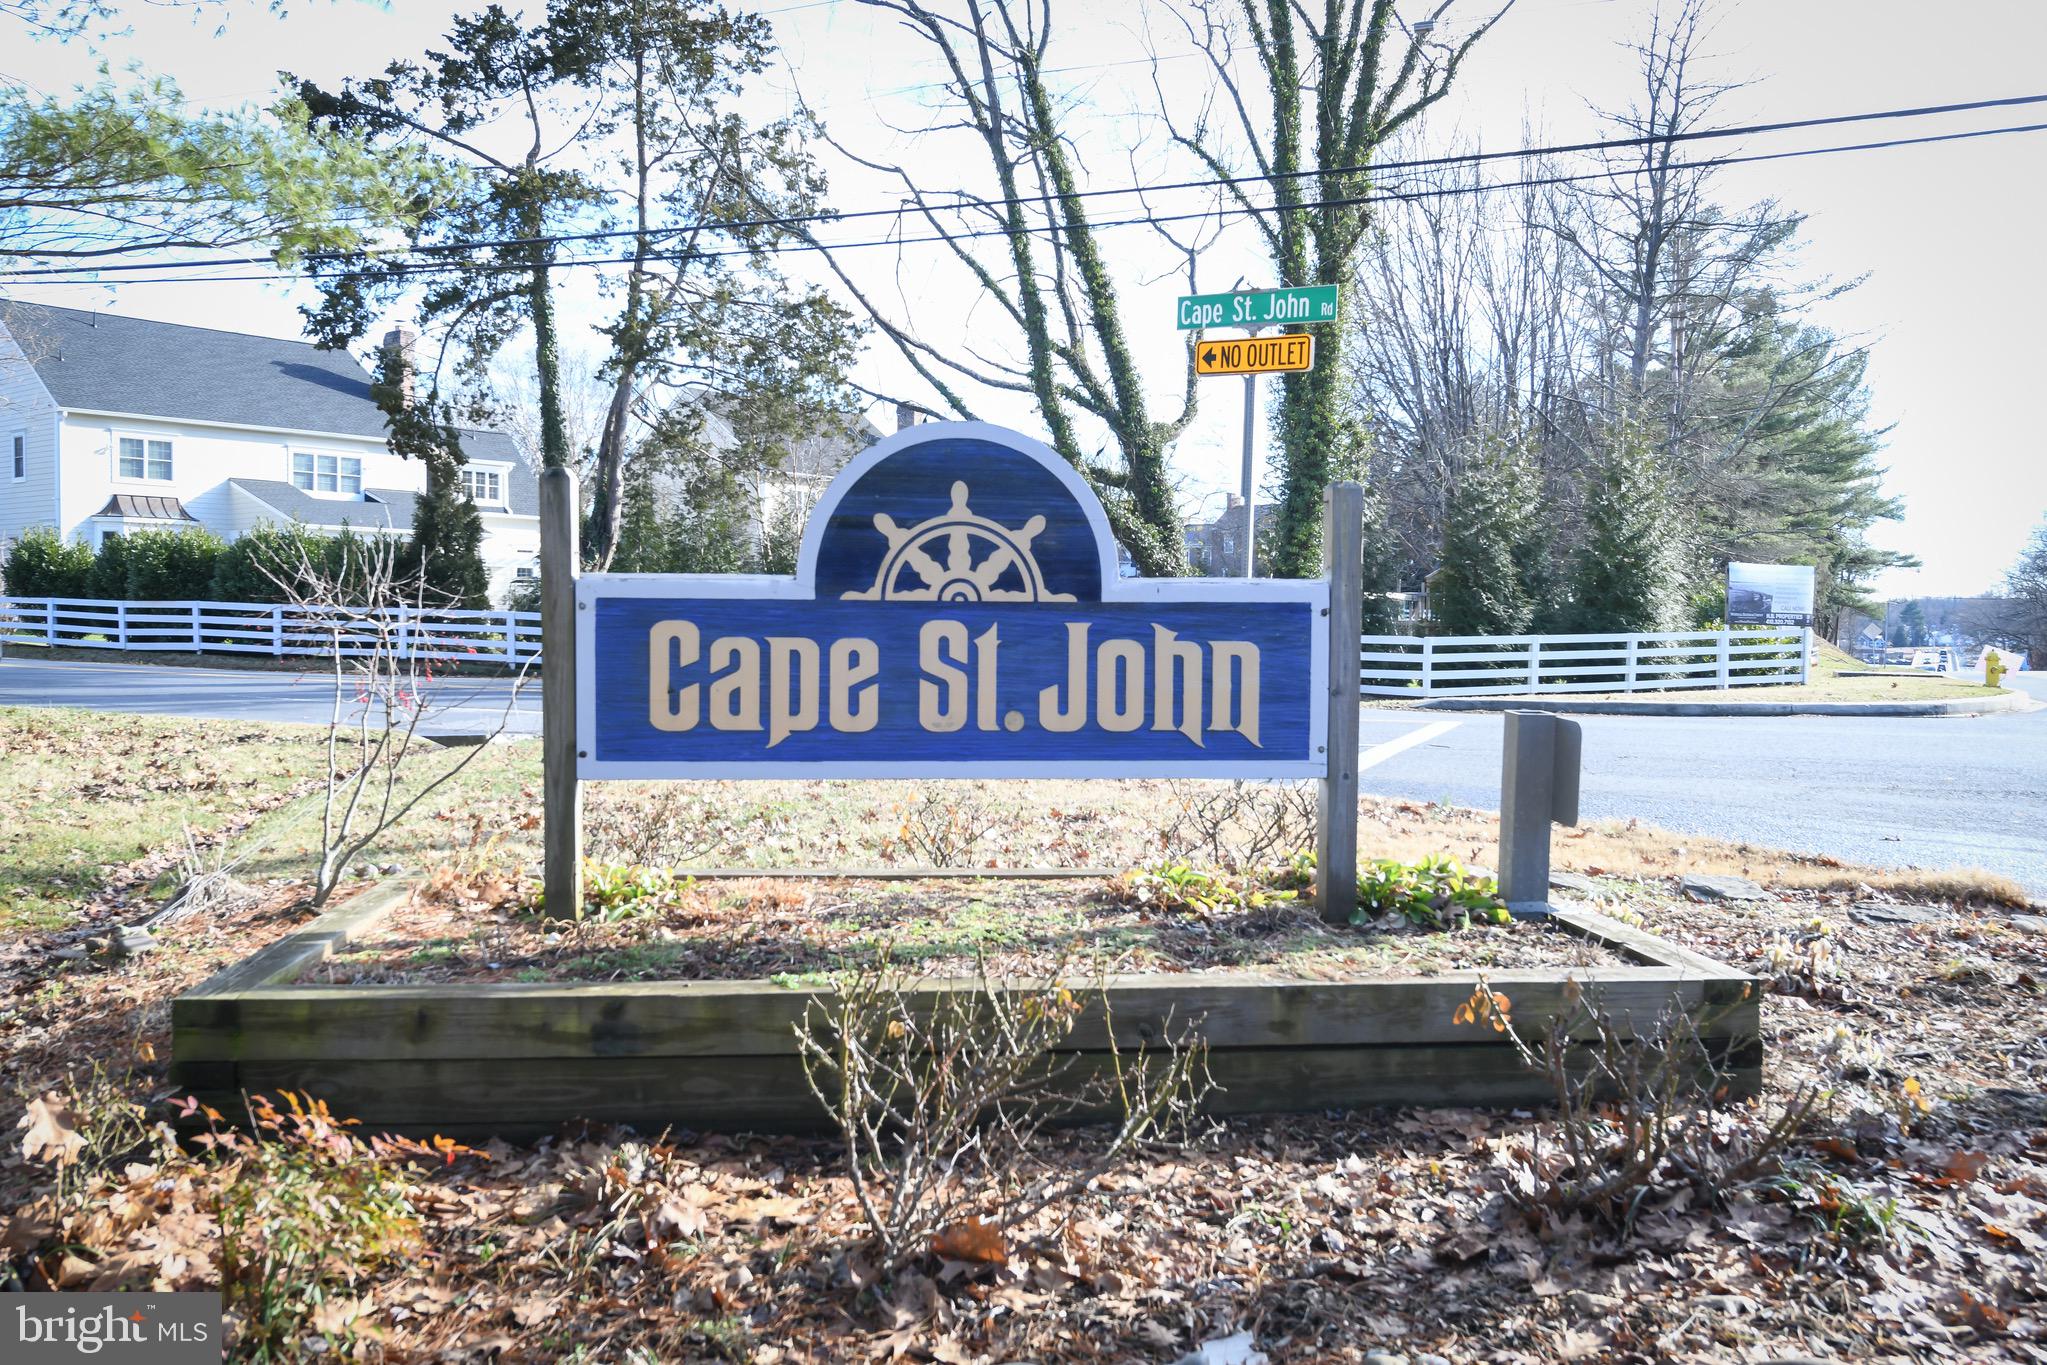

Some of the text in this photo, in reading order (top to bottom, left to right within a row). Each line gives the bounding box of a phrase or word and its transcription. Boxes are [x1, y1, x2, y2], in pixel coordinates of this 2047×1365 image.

[1181, 293, 1333, 328] Cape St. John Rd
[1220, 341, 1306, 368] NO OUTLET
[649, 619, 1263, 749] Cape St. John
